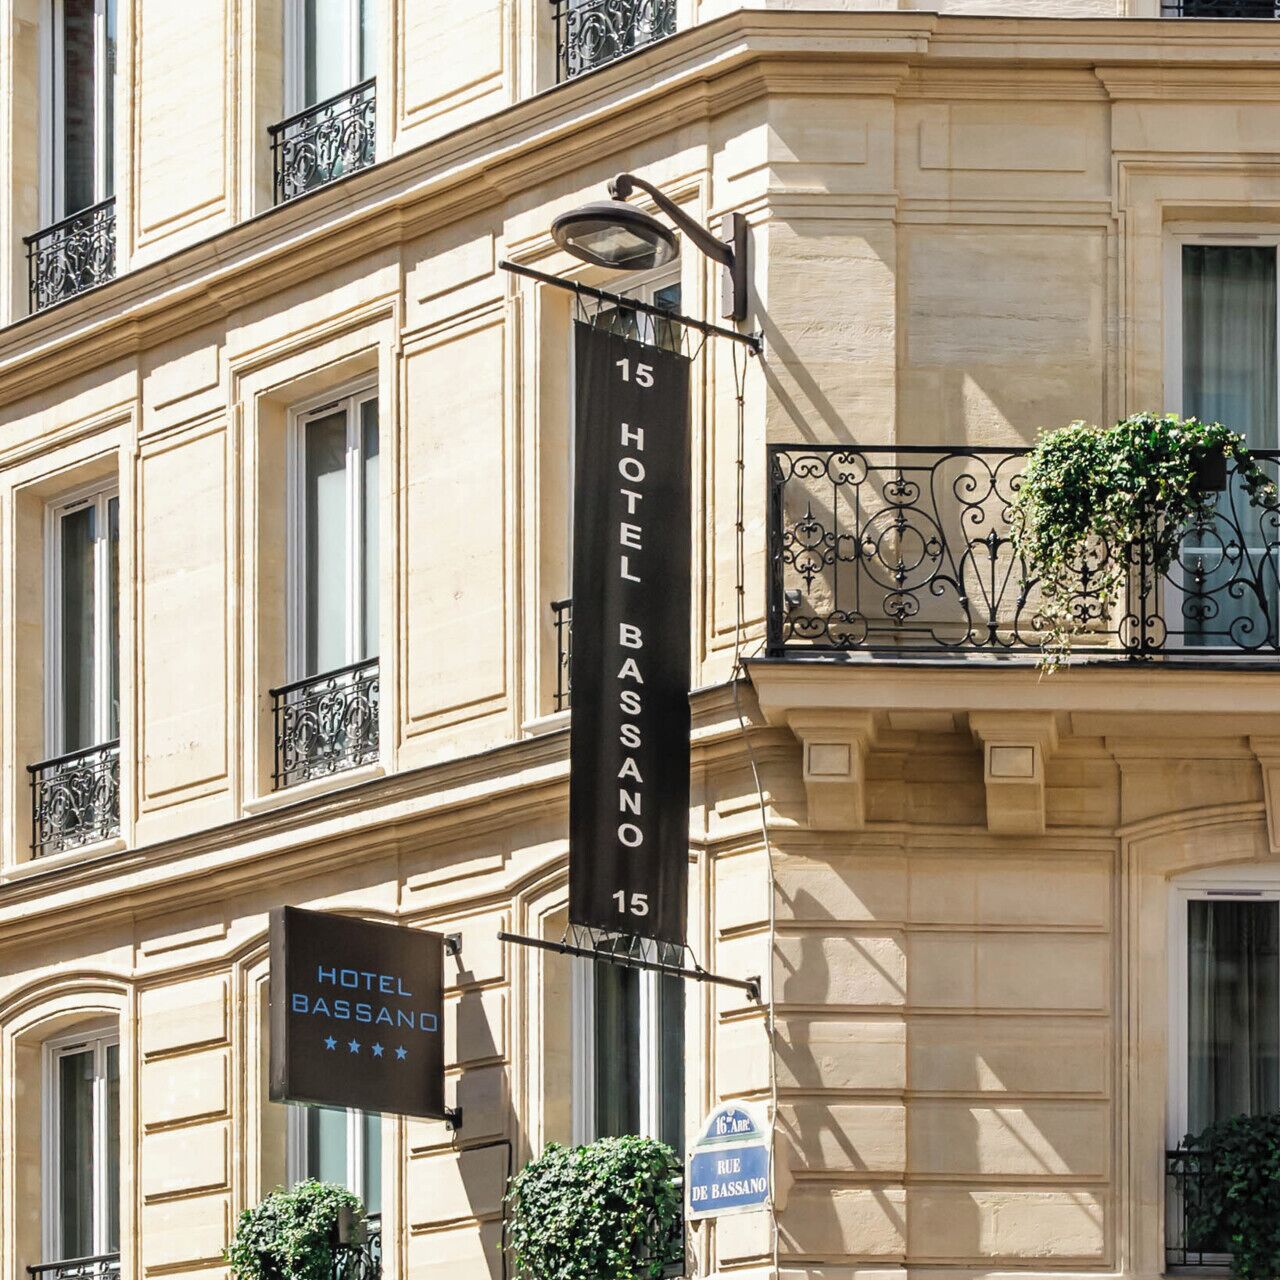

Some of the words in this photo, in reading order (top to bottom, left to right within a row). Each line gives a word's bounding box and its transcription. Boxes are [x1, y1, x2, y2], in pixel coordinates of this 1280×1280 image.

[615, 357, 654, 389] 15
[617, 422, 645, 583] HOTEL
[615, 623, 644, 850] BASSANO
[612, 889, 649, 918] 15
[317, 965, 413, 998] HOTEL
[291, 993, 438, 1033] BASSANO
[717, 1158, 741, 1175] RUE
[692, 1185, 708, 1201] DE
[711, 1177, 767, 1199] BASSANO
